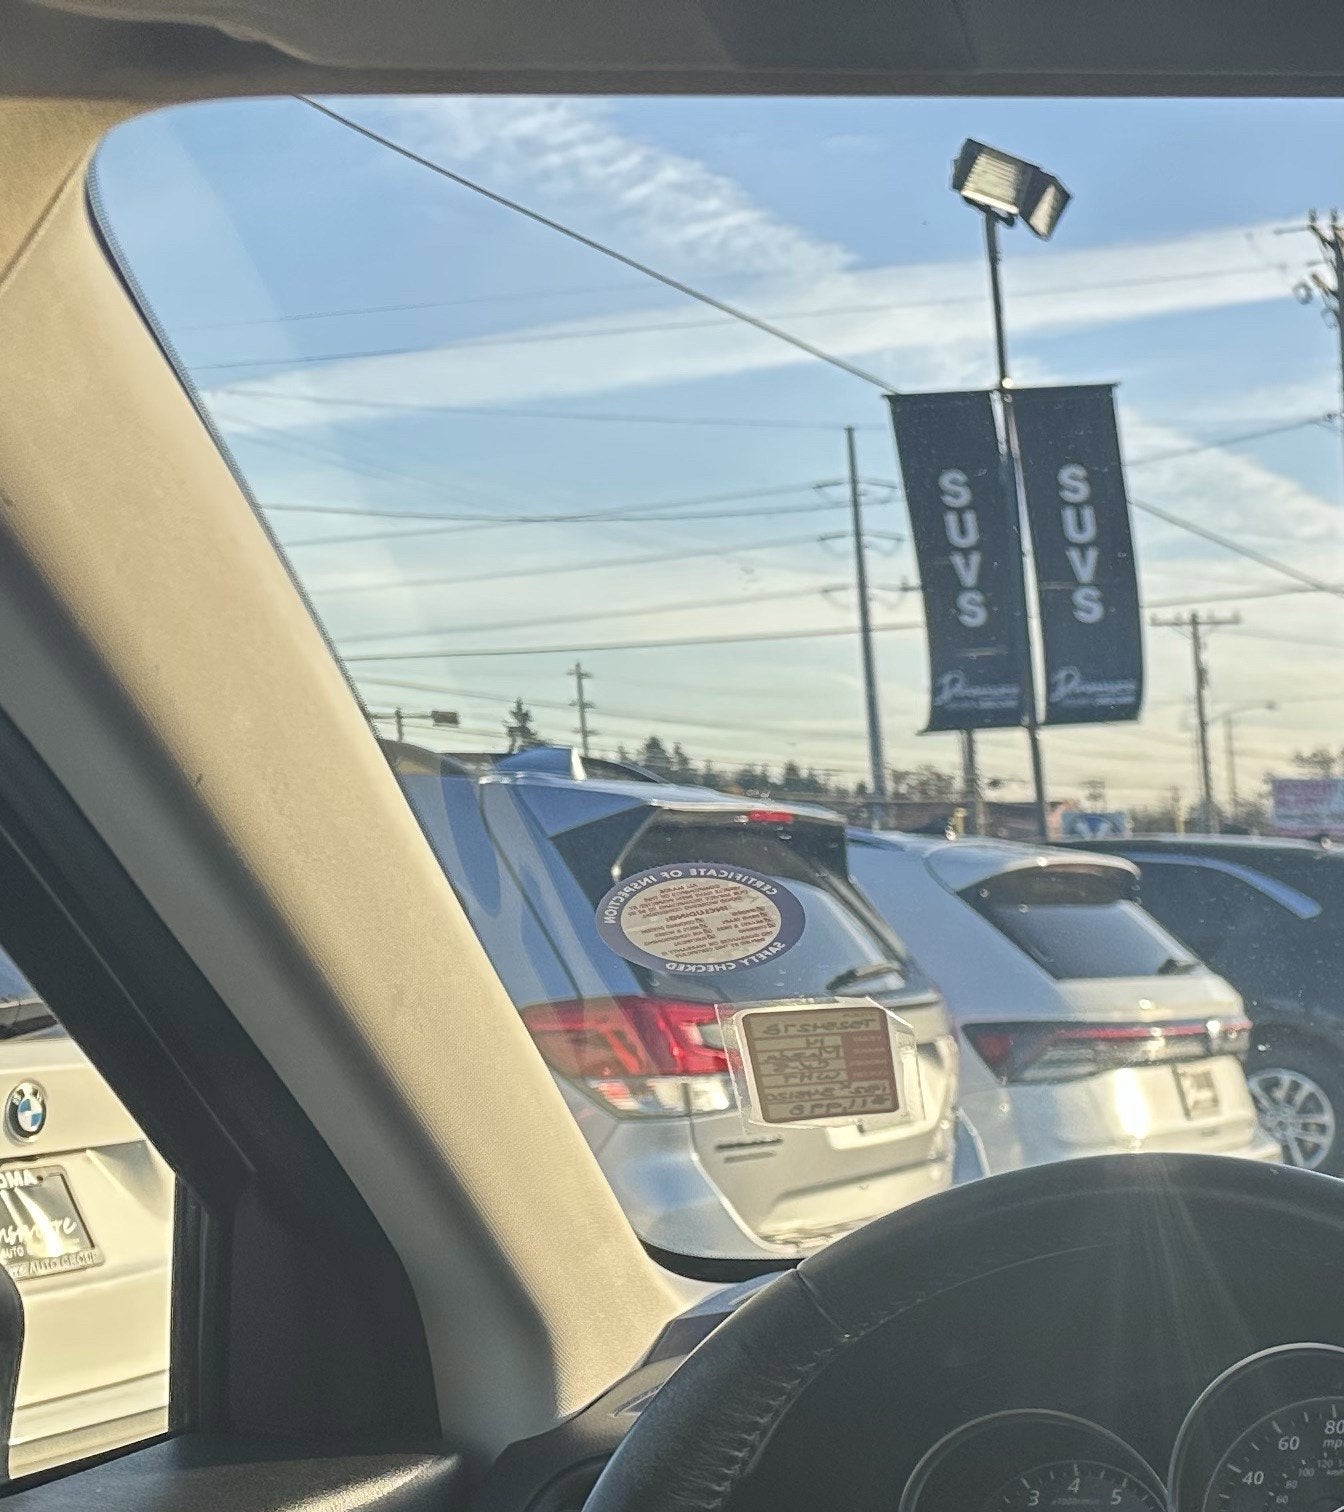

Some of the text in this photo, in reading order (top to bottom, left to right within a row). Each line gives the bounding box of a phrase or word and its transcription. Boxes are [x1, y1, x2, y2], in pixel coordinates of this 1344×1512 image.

[939, 468, 988, 629] SUVS
[1057, 462, 1104, 624] SUVS
[1277, 1435, 1300, 1451] 60
[1316, 1459, 1334, 1469] 120
[1241, 1470, 1265, 1486] 40
[1298, 1468, 1315, 1478] 100
[1067, 1477, 1081, 1494] 4
[1028, 1489, 1041, 1507] 3
[1110, 1489, 1123, 1506] 5
